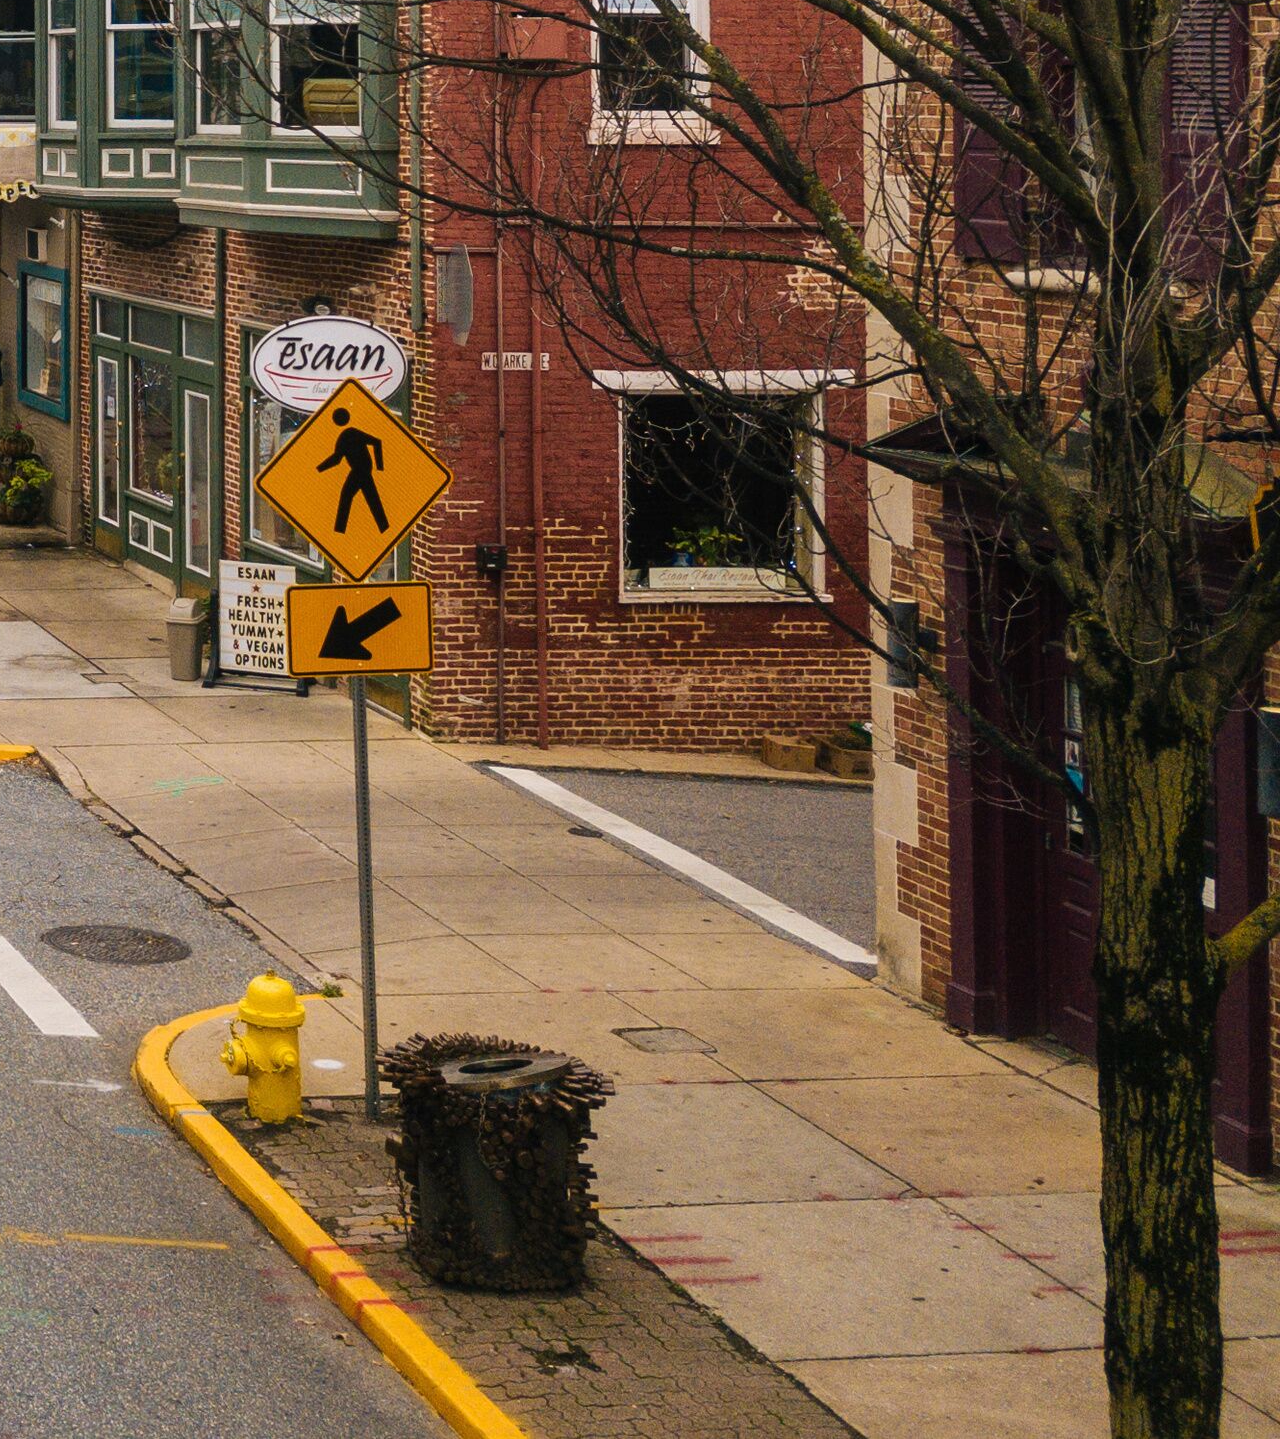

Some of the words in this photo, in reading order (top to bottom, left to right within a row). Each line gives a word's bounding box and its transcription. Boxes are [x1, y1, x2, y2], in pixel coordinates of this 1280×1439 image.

[493, 354, 528, 369] CARKE
[237, 566, 277, 582] ESAAN
[690, 568, 718, 582] Thai
[236, 595, 276, 610] FRESH
[228, 608, 282, 625] HEALTHY
[230, 623, 276, 640] YUMMY
[232, 639, 240, 650] &
[246, 639, 285, 655] VEGAN
[234, 653, 285, 670] OPTIONS
